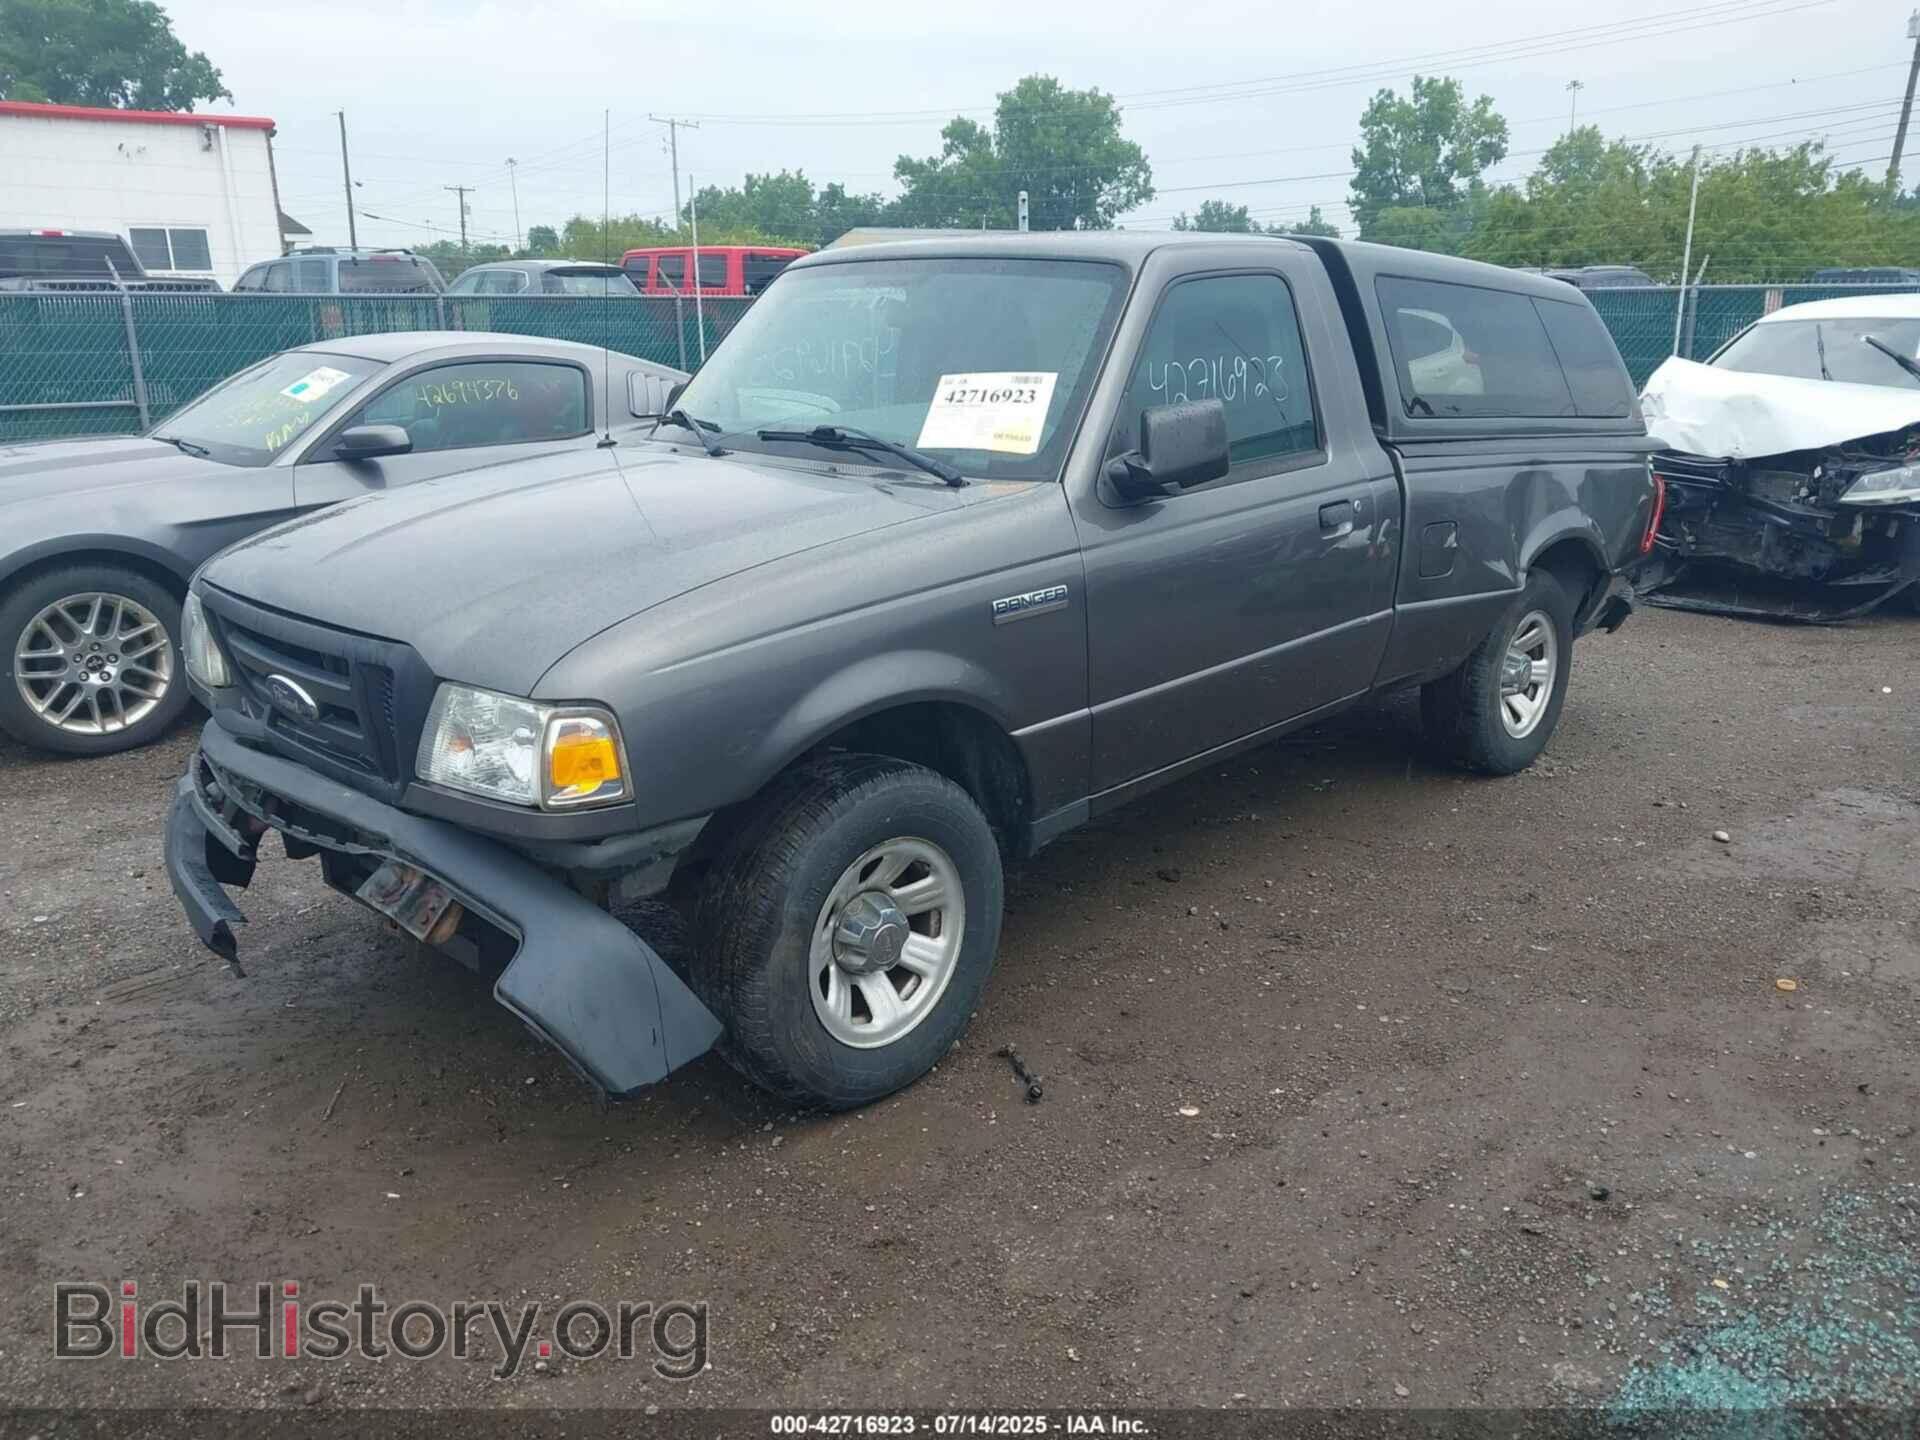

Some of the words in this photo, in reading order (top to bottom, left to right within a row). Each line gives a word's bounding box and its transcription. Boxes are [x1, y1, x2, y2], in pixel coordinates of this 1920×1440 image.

[416, 375, 520, 408] 42694376
[944, 384, 1037, 404] 42716923
[1149, 355, 1289, 405] 42716923
[995, 588, 1065, 613] RANGER
